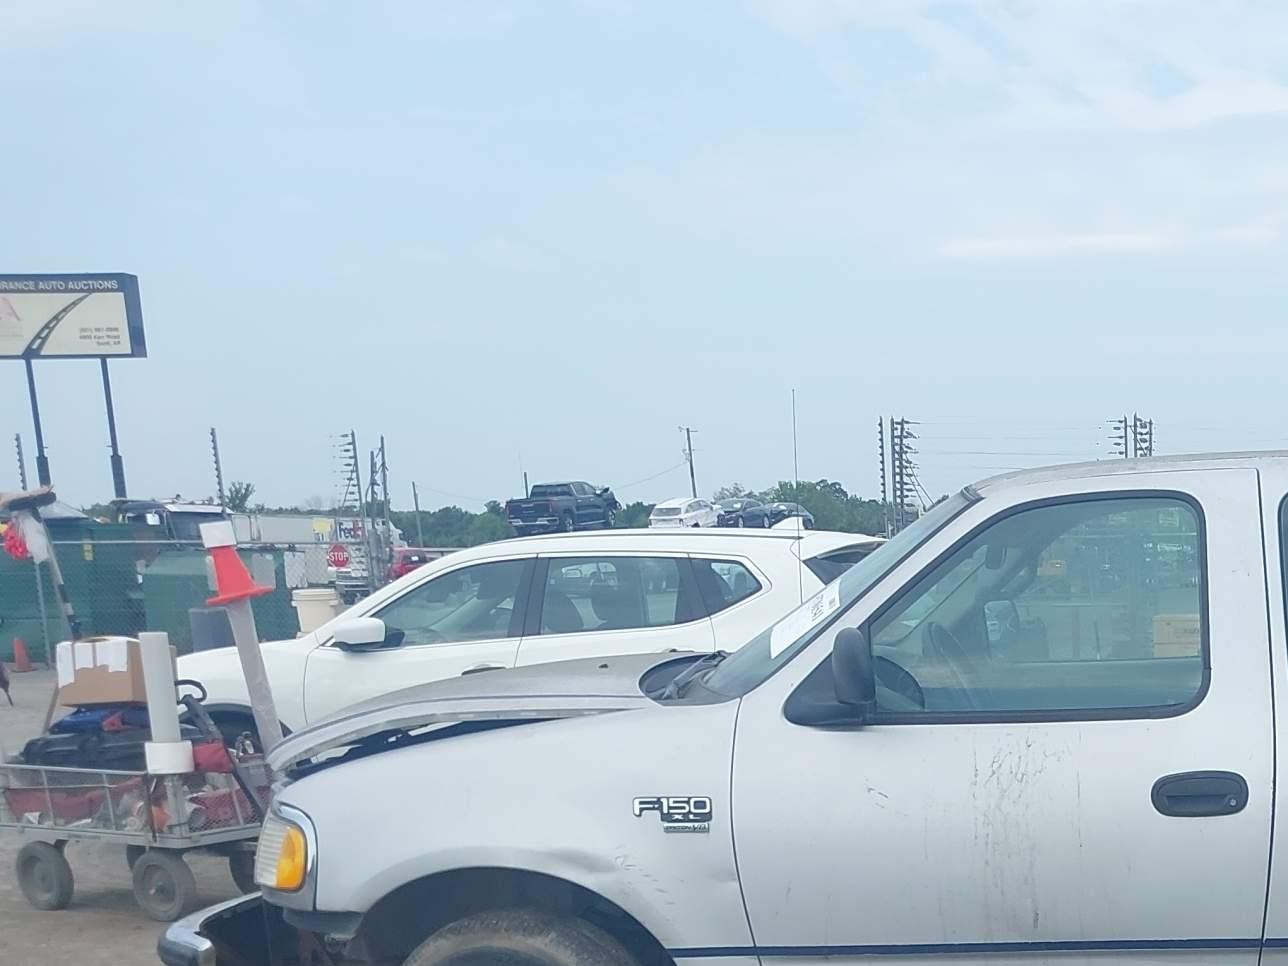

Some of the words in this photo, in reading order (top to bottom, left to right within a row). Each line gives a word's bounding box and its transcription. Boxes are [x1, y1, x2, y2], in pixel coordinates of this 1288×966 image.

[0, 280, 35, 290] RANCE
[38, 280, 65, 290] AUTO
[68, 279, 118, 289] AUCTIONS
[329, 551, 349, 561] STOP
